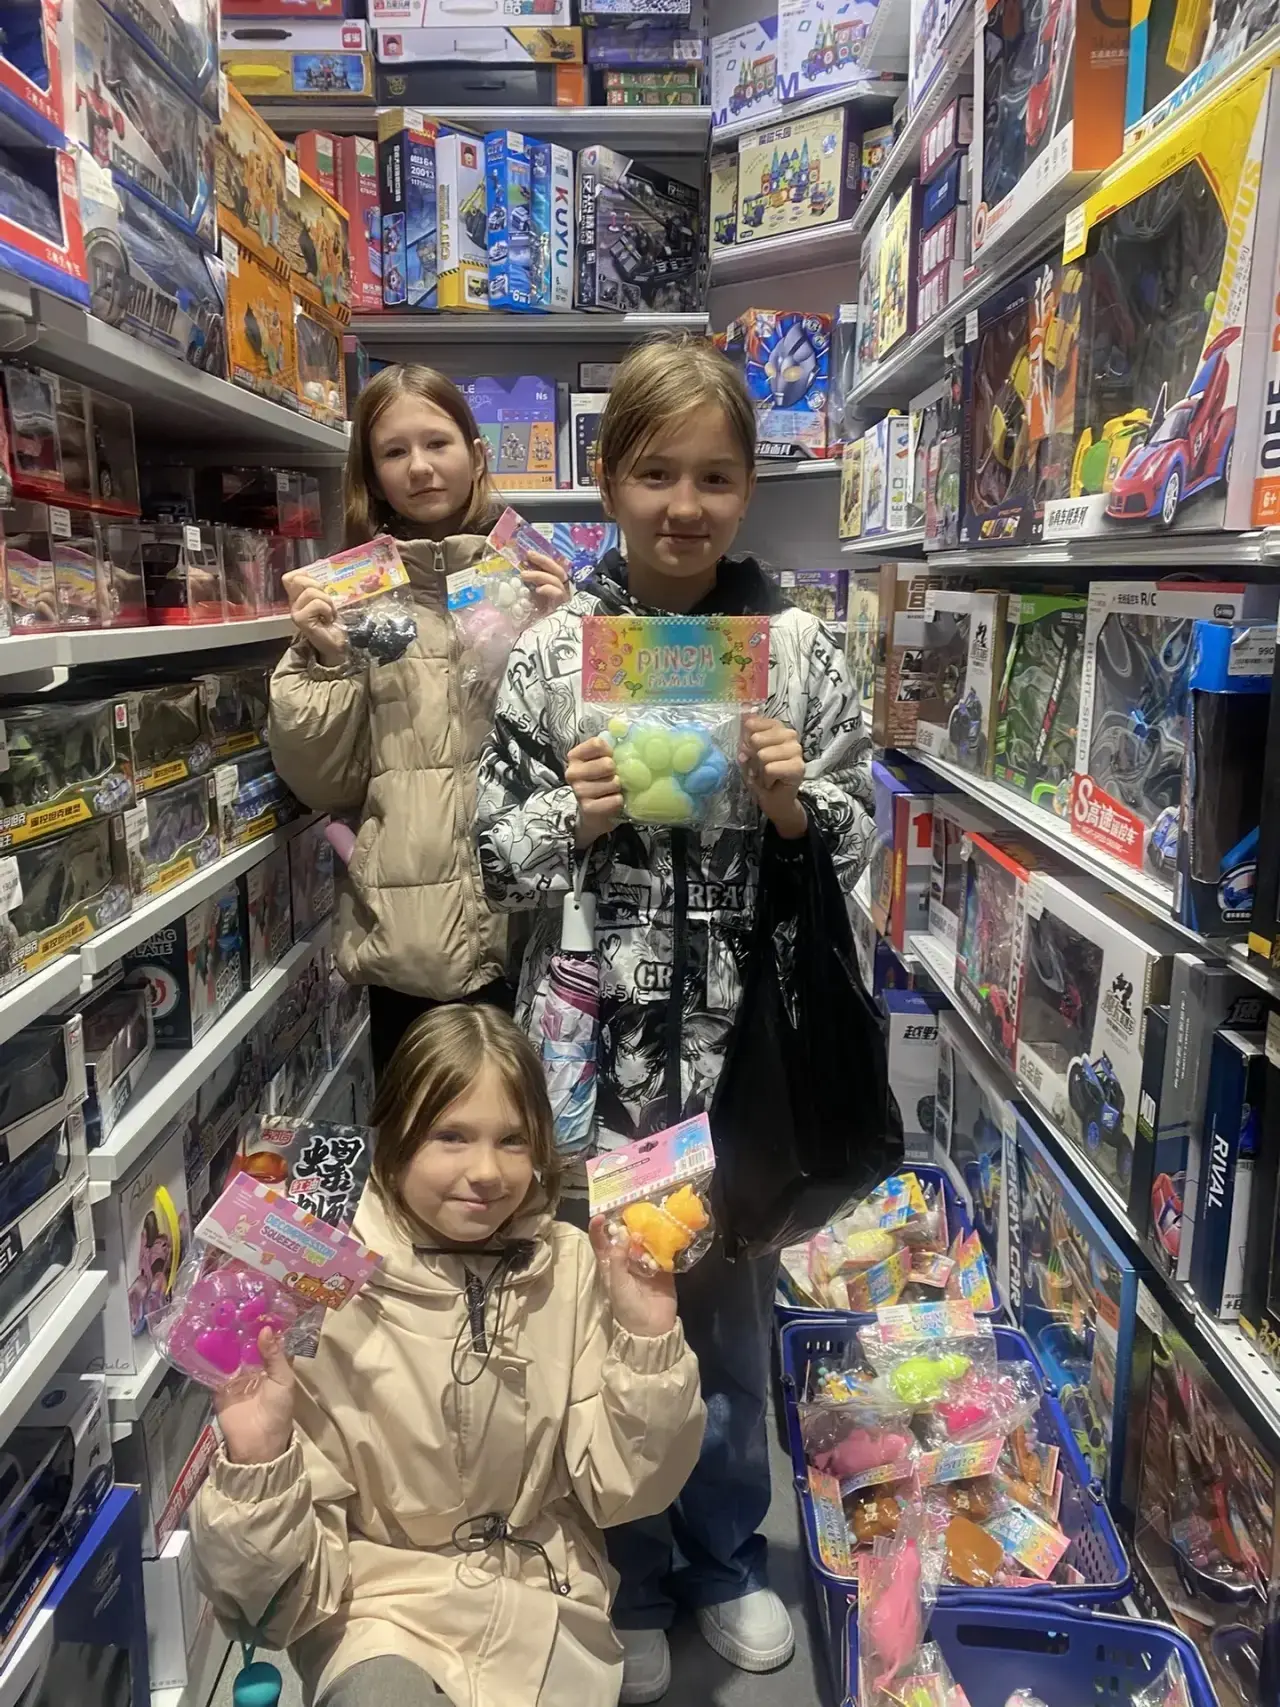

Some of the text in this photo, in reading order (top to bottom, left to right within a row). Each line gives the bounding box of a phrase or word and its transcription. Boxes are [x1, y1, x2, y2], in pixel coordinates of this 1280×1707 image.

[555, 186, 569, 268] KUYU
[1140, 592, 1157, 607] R/C
[601, 983, 650, 1005] ように
[903, 1025, 939, 1041] 越野
[1208, 1133, 1229, 1208] RIVAL
[1005, 1138, 1021, 1308] SPRAY CAR
[260, 1224, 300, 1252] SQUEEZE
